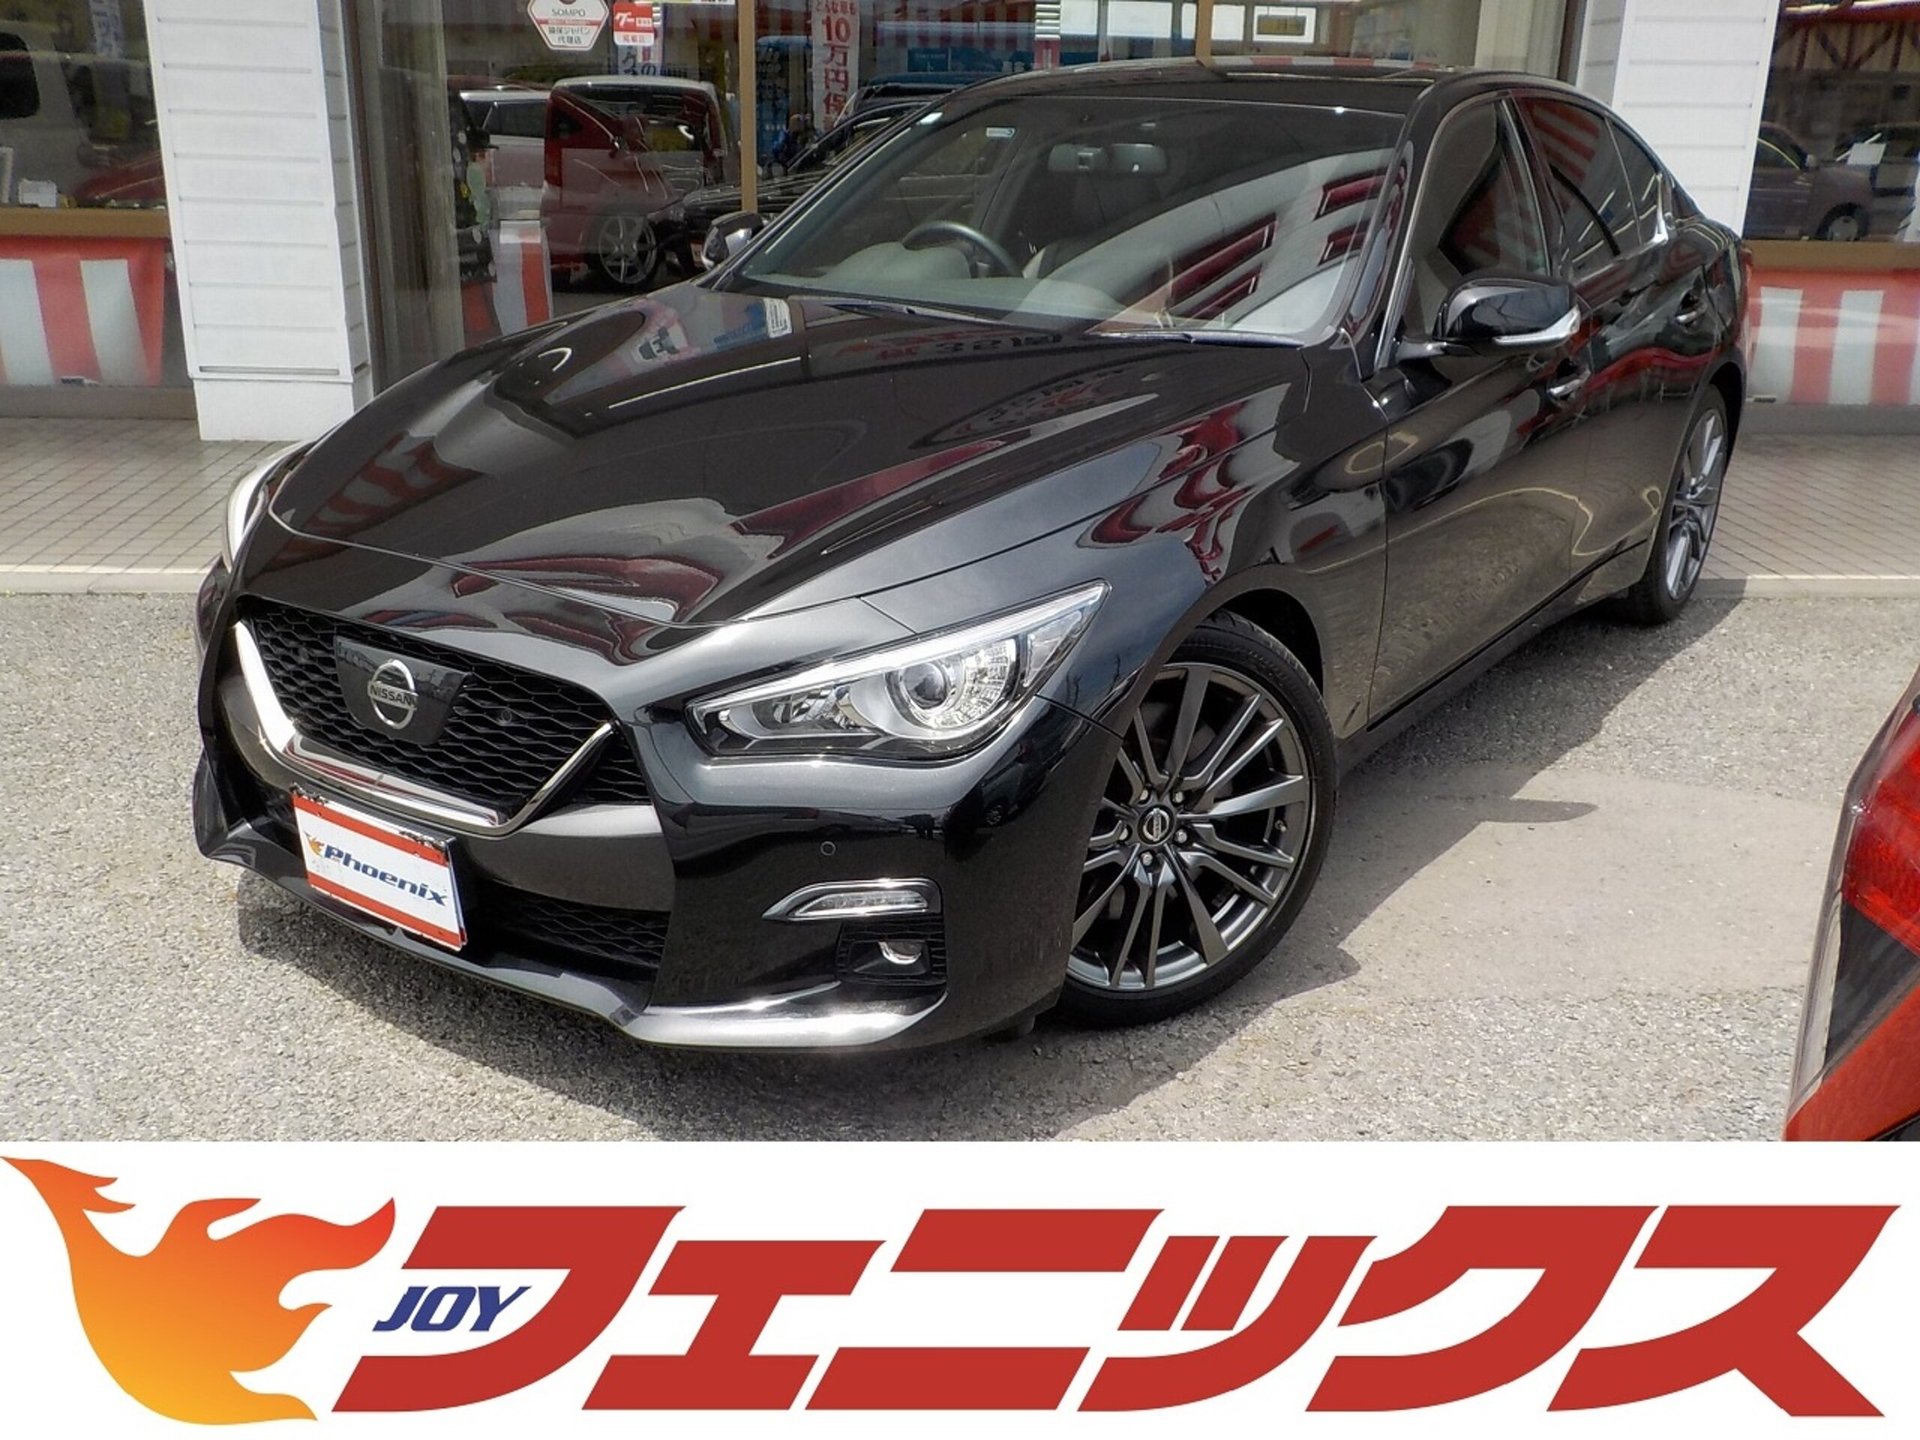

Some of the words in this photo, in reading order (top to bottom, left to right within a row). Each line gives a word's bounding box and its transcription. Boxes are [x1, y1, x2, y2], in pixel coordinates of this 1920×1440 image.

[552, 8, 586, 17] SOMPO
[370, 684, 413, 706] NISSAN
[324, 844, 448, 907] Phoenix
